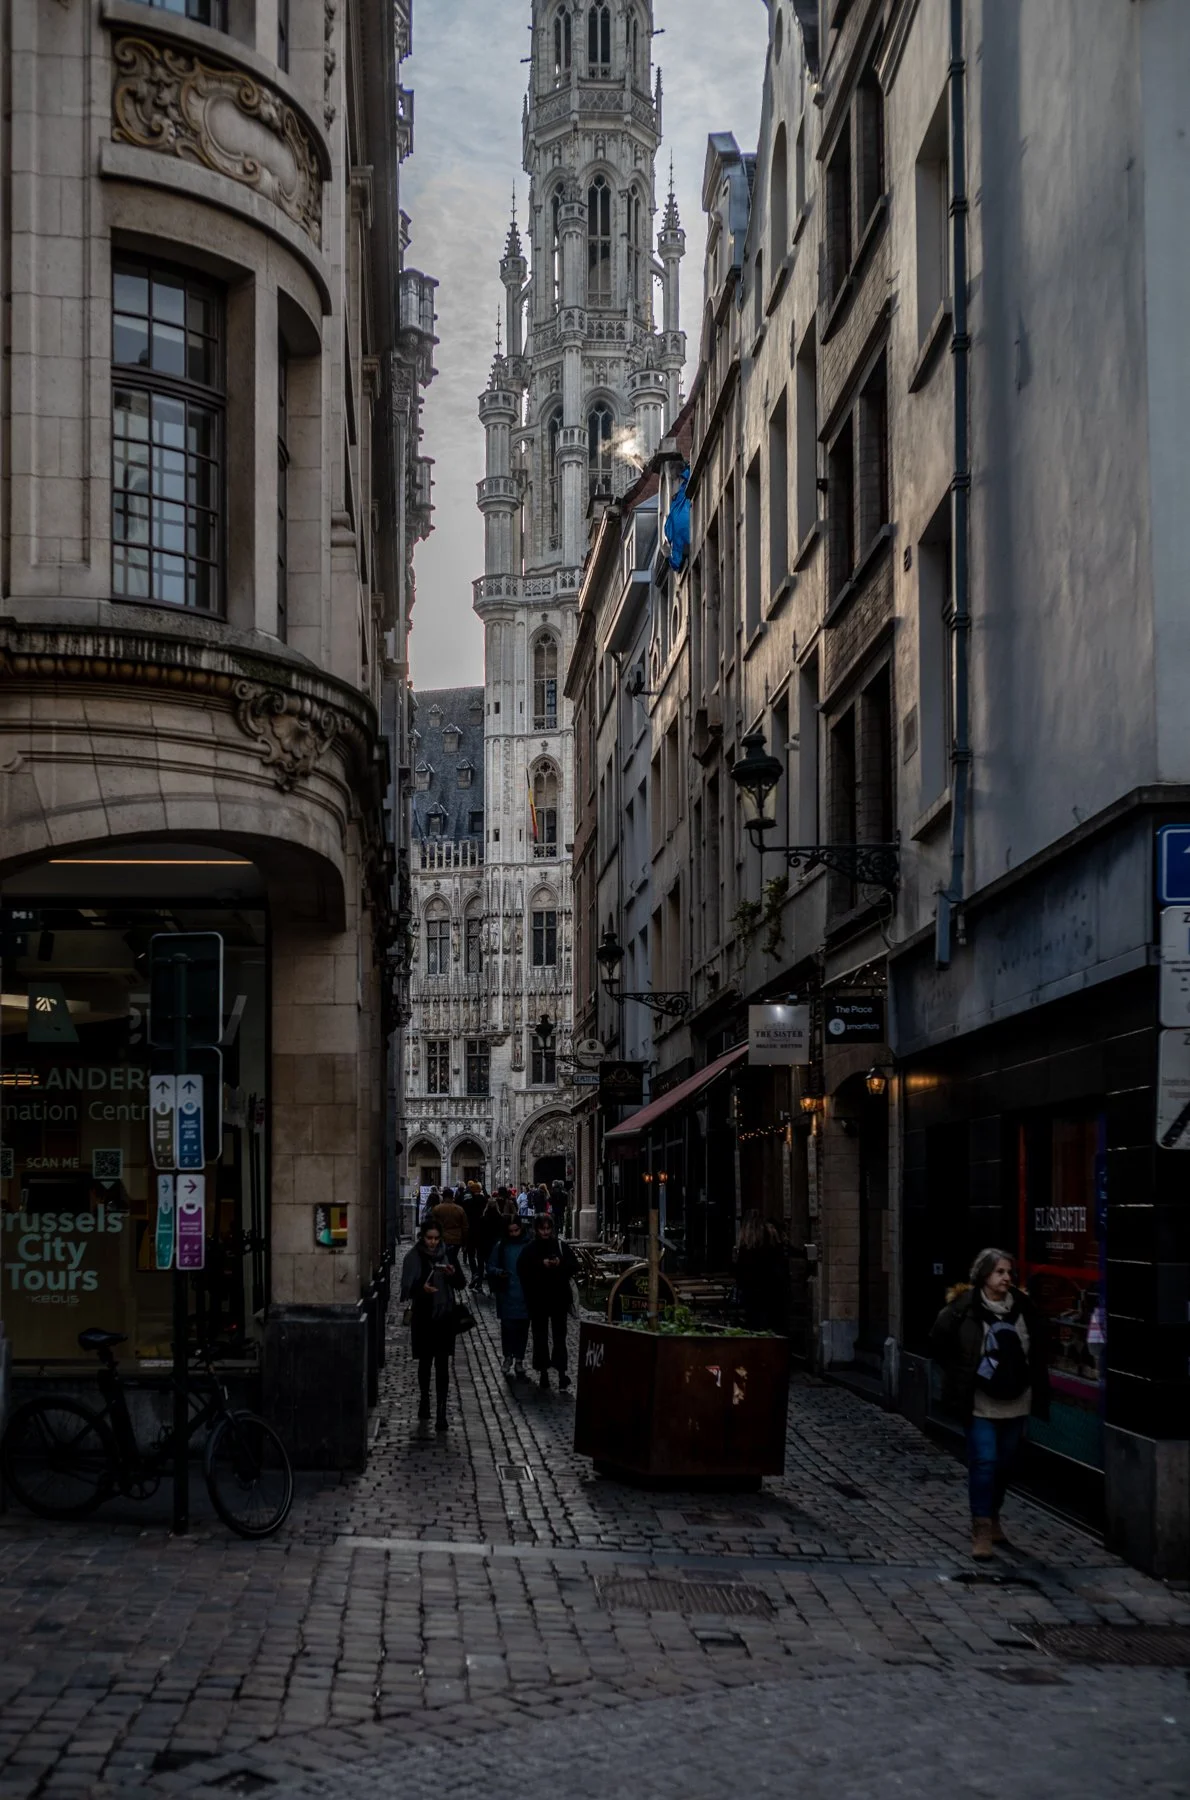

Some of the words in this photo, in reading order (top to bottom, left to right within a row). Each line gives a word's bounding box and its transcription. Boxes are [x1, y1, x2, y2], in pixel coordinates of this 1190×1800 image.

[773, 1030, 803, 1038] SISTER
[26, 1157, 60, 1169] SCAN
[61, 1157, 80, 1169] ME
[2, 1203, 123, 1232] russels
[17, 1234, 88, 1270] City
[4, 1262, 99, 1291] Tours
